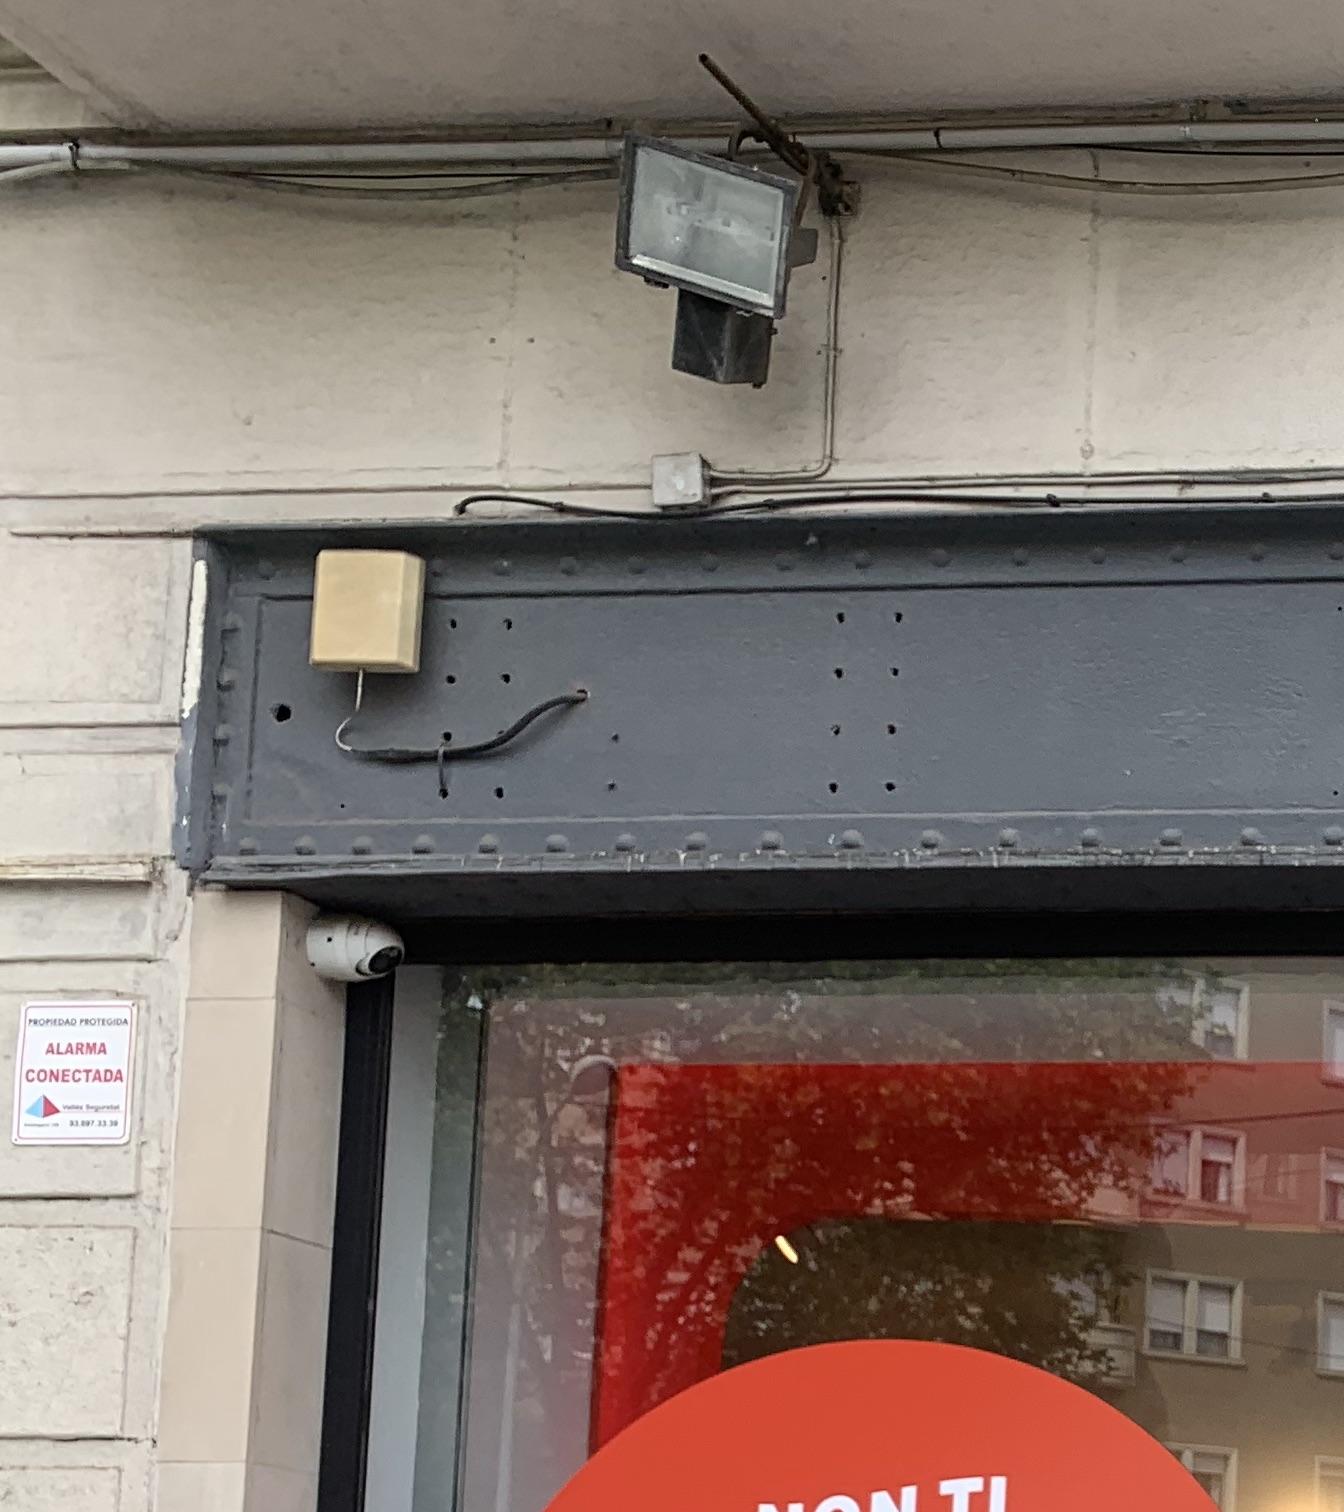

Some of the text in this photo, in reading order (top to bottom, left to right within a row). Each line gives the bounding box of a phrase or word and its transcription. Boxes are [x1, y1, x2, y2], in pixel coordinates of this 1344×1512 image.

[28, 1018, 129, 1027] PROPIEDAD PROTEGIDA
[45, 1042, 108, 1055] ALARMA
[25, 1069, 124, 1083] CONECTADA
